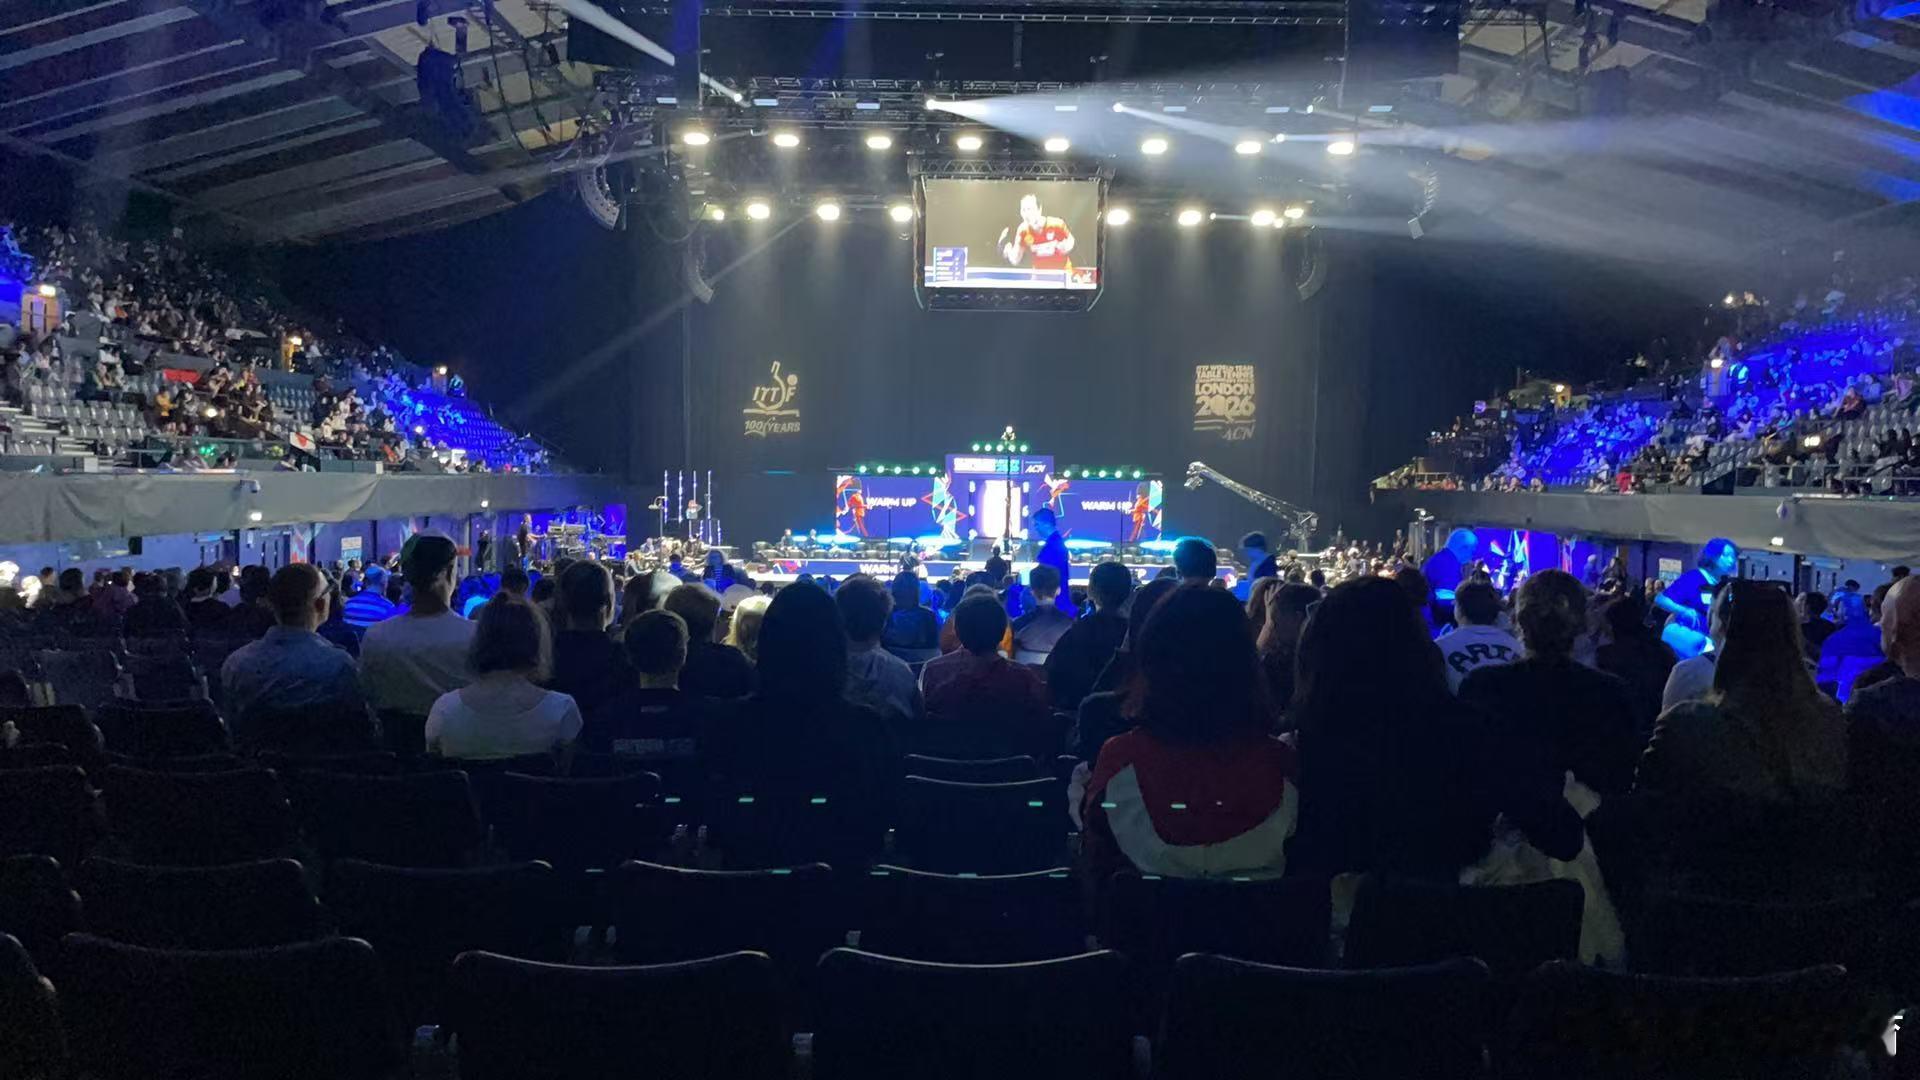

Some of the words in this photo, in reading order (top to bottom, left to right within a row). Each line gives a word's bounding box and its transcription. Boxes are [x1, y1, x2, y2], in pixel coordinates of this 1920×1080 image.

[752, 386, 796, 402] ITTF
[1195, 383, 1255, 395] LONDON
[1195, 395, 1256, 416] 2026
[744, 420, 763, 430] 100
[768, 422, 801, 433] YEARS
[1222, 424, 1256, 440] ACN
[1025, 464, 1046, 473] ACN
[866, 497, 899, 507] WARM
[901, 497, 917, 507] UP
[1081, 501, 1115, 510] WARM
[859, 563, 898, 574] WARM
